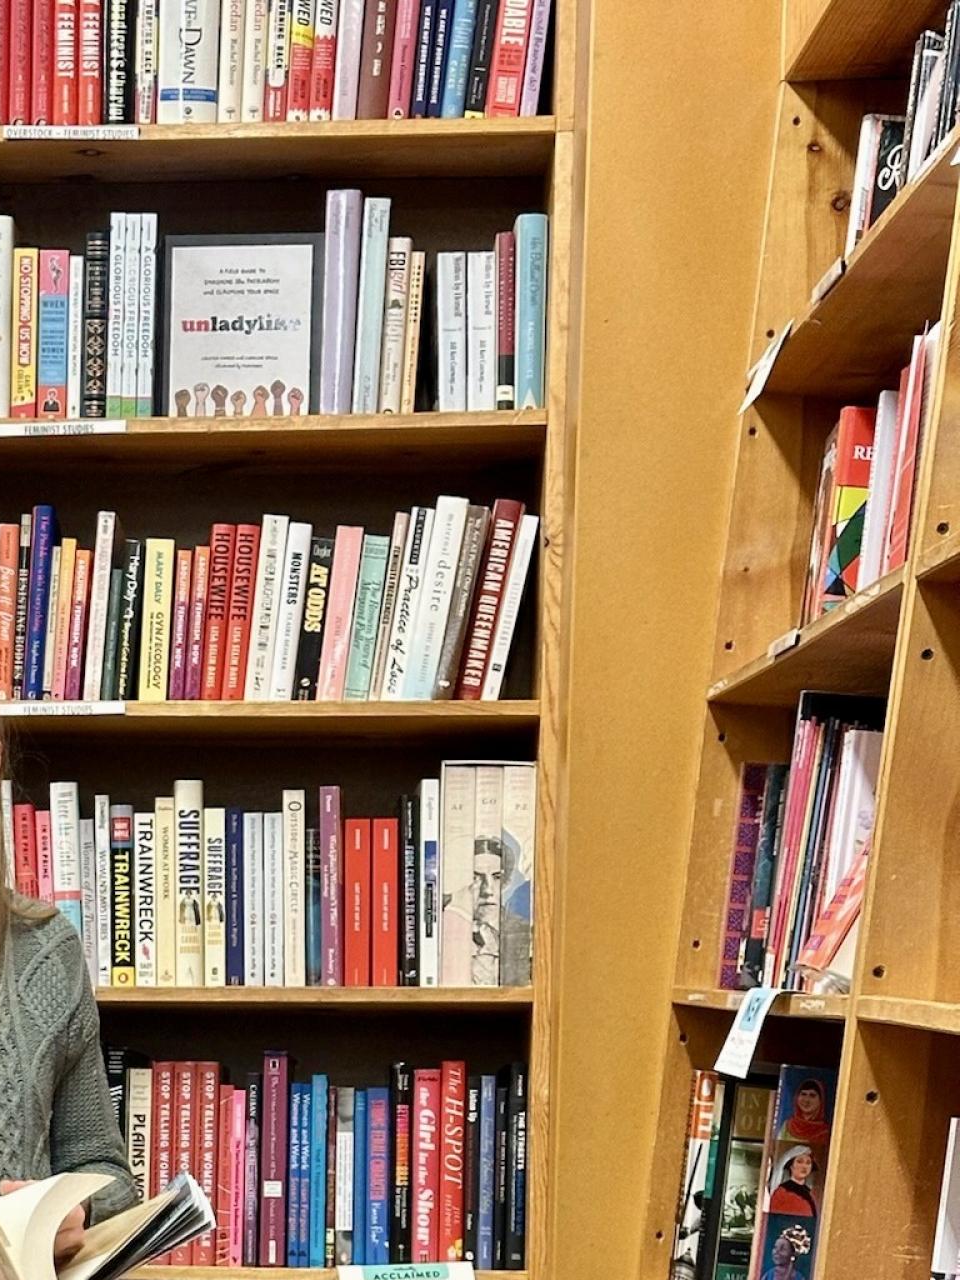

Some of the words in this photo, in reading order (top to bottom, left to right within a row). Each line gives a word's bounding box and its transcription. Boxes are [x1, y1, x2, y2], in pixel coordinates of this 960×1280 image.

[58, 12, 75, 78] FEMINIST
[82, 12, 100, 78] FEMINIST
[180, 27, 202, 84] DAWN
[6, 128, 54, 139] OVERSTOCK
[63, 128, 102, 139] FEMINIST
[104, 128, 135, 139] STUDIES
[20, 259, 31, 273] NO
[113, 255, 121, 306] GLORIOUS
[20, 276, 31, 321] STOPPING
[20, 327, 31, 341] US
[20, 342, 31, 365] NOW
[112, 309, 121, 357] FREEDOM
[23, 424, 59, 434] FEMINIST
[61, 423, 95, 433] STUDIES
[209, 533, 231, 622] HOUSEWIFE
[232, 533, 254, 622] HOUSEWIFE
[286, 552, 303, 605] MONSTERS
[311, 563, 328, 585] AT
[480, 518, 515, 591] AMERICAN
[304, 588, 327, 633] ODDS
[430, 560, 451, 612] desire
[462, 594, 499, 687] QUEENMAKER
[179, 810, 201, 895] SUFFRAGE
[207, 838, 222, 896] SUFFRAGE
[139, 819, 154, 943] TRAINWRECK
[115, 851, 131, 963] TRAINWRECK
[205, 1072, 214, 1098] STOP
[448, 1068, 461, 1093] The
[132, 1114, 146, 1167] PLAINS
[204, 1104, 213, 1147] TELLING
[444, 1096, 464, 1188] H-SPOT
[203, 1151, 213, 1192] WOMEN
[373, 1269, 442, 1280] ACCLAIMED
